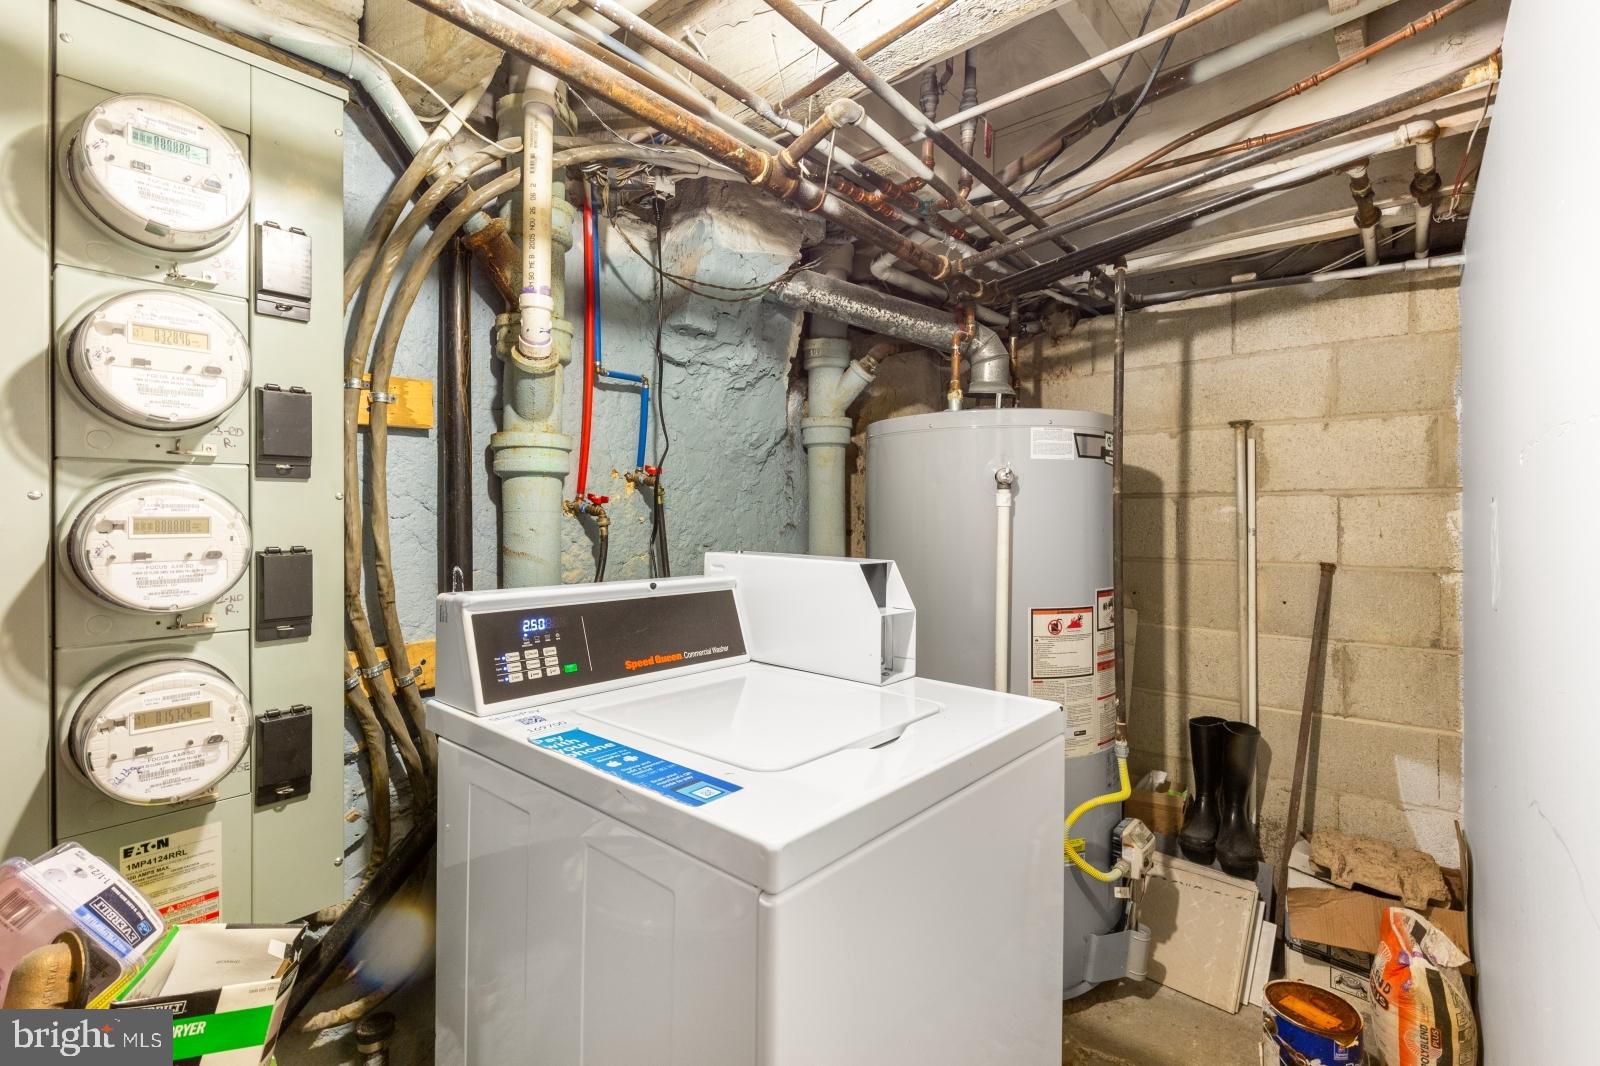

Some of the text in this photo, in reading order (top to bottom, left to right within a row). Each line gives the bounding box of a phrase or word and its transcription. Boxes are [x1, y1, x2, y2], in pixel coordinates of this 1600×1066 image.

[528, 233, 536, 250] 2005
[624, 645, 729, 671] Speed Queen Commercial Washer
[532, 734, 564, 745] Pay
[567, 742, 617, 758] phone
[147, 754, 169, 763] FOCUS
[126, 849, 188, 872] 1MP4124RRL
[137, 869, 155, 879] AMPS
[155, 865, 171, 874] MAX
[176, 895, 206, 909] DANGER
[94, 899, 138, 943] EVERBILT
[1431, 1028, 1441, 1048] PLUS
